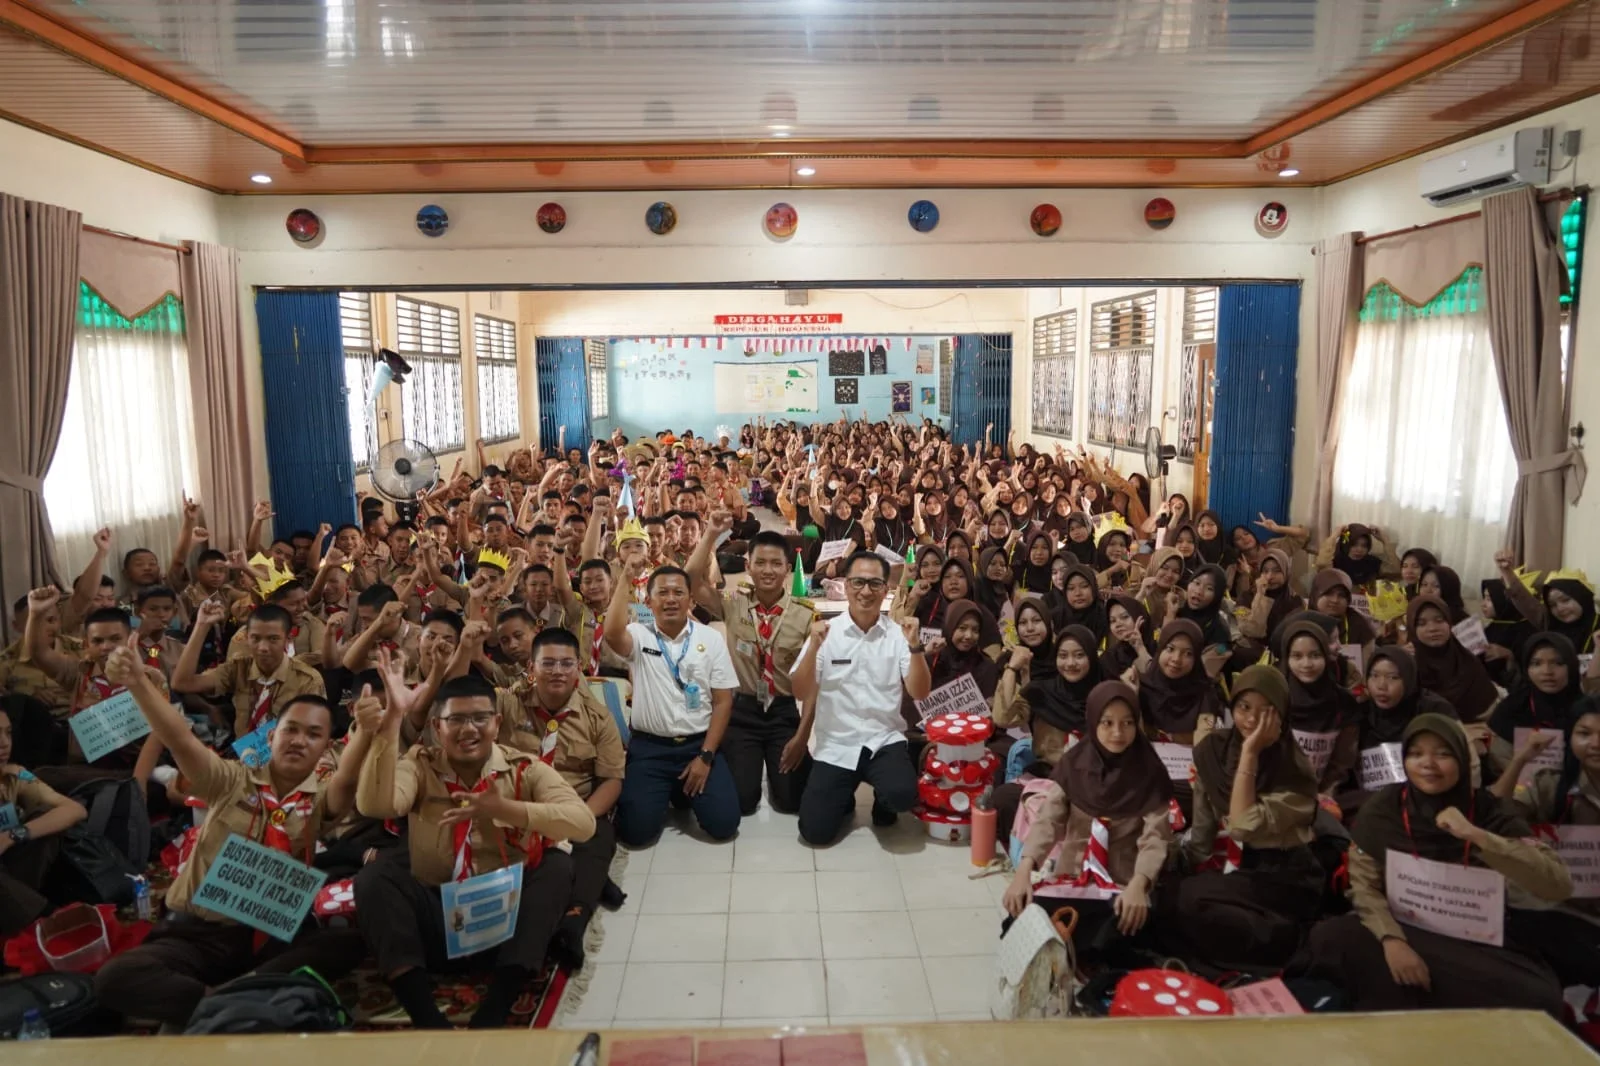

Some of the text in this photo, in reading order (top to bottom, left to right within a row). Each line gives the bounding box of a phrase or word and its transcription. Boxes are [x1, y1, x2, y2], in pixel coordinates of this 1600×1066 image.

[727, 315, 829, 325] DIRGAHAYU
[919, 689, 951, 713] AMANDA
[222, 840, 263, 870] BUSTAN
[256, 854, 289, 881] PUTRA
[200, 883, 297, 933] SMPN 1 KAYUAGUNG
[217, 863, 305, 914] GUGUS 1 (ATLAS)
